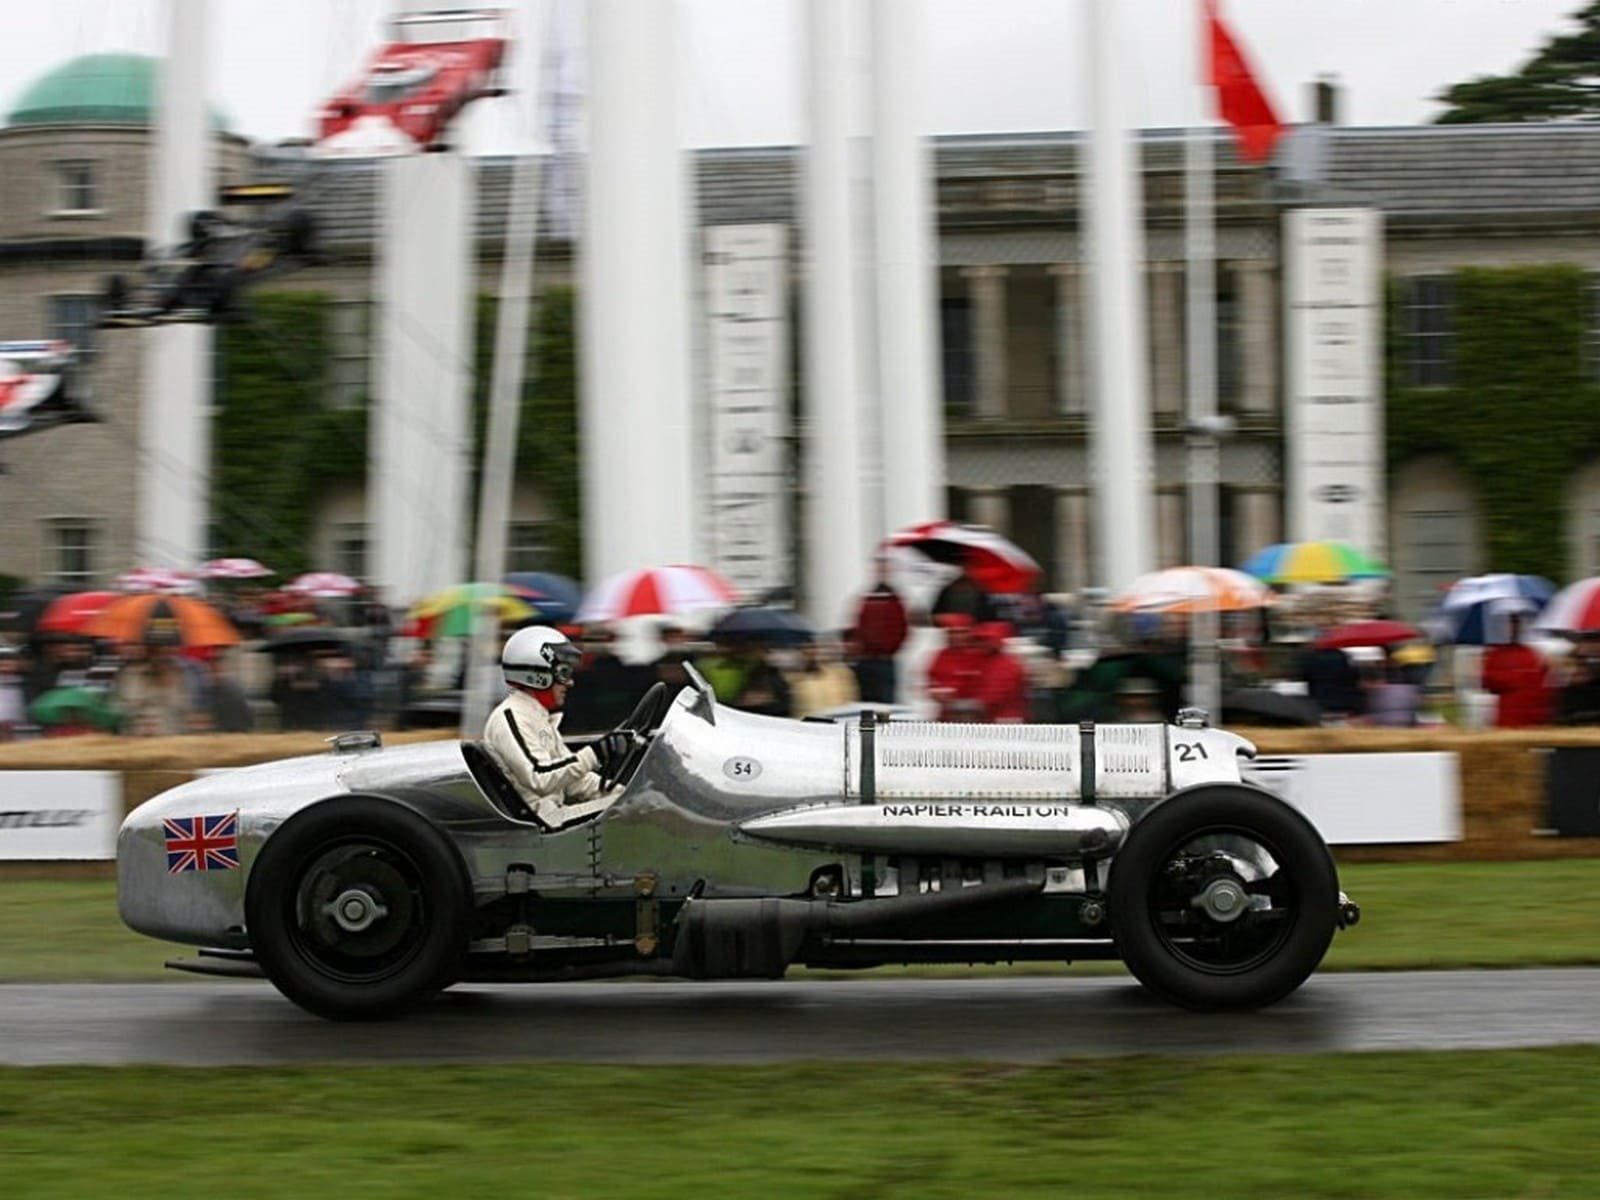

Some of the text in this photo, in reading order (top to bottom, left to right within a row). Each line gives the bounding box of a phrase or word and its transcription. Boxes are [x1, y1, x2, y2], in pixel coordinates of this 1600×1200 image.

[1174, 741, 1208, 762] 21
[734, 761, 751, 775] 54
[883, 804, 1069, 817] NAPIER-RAILTON
